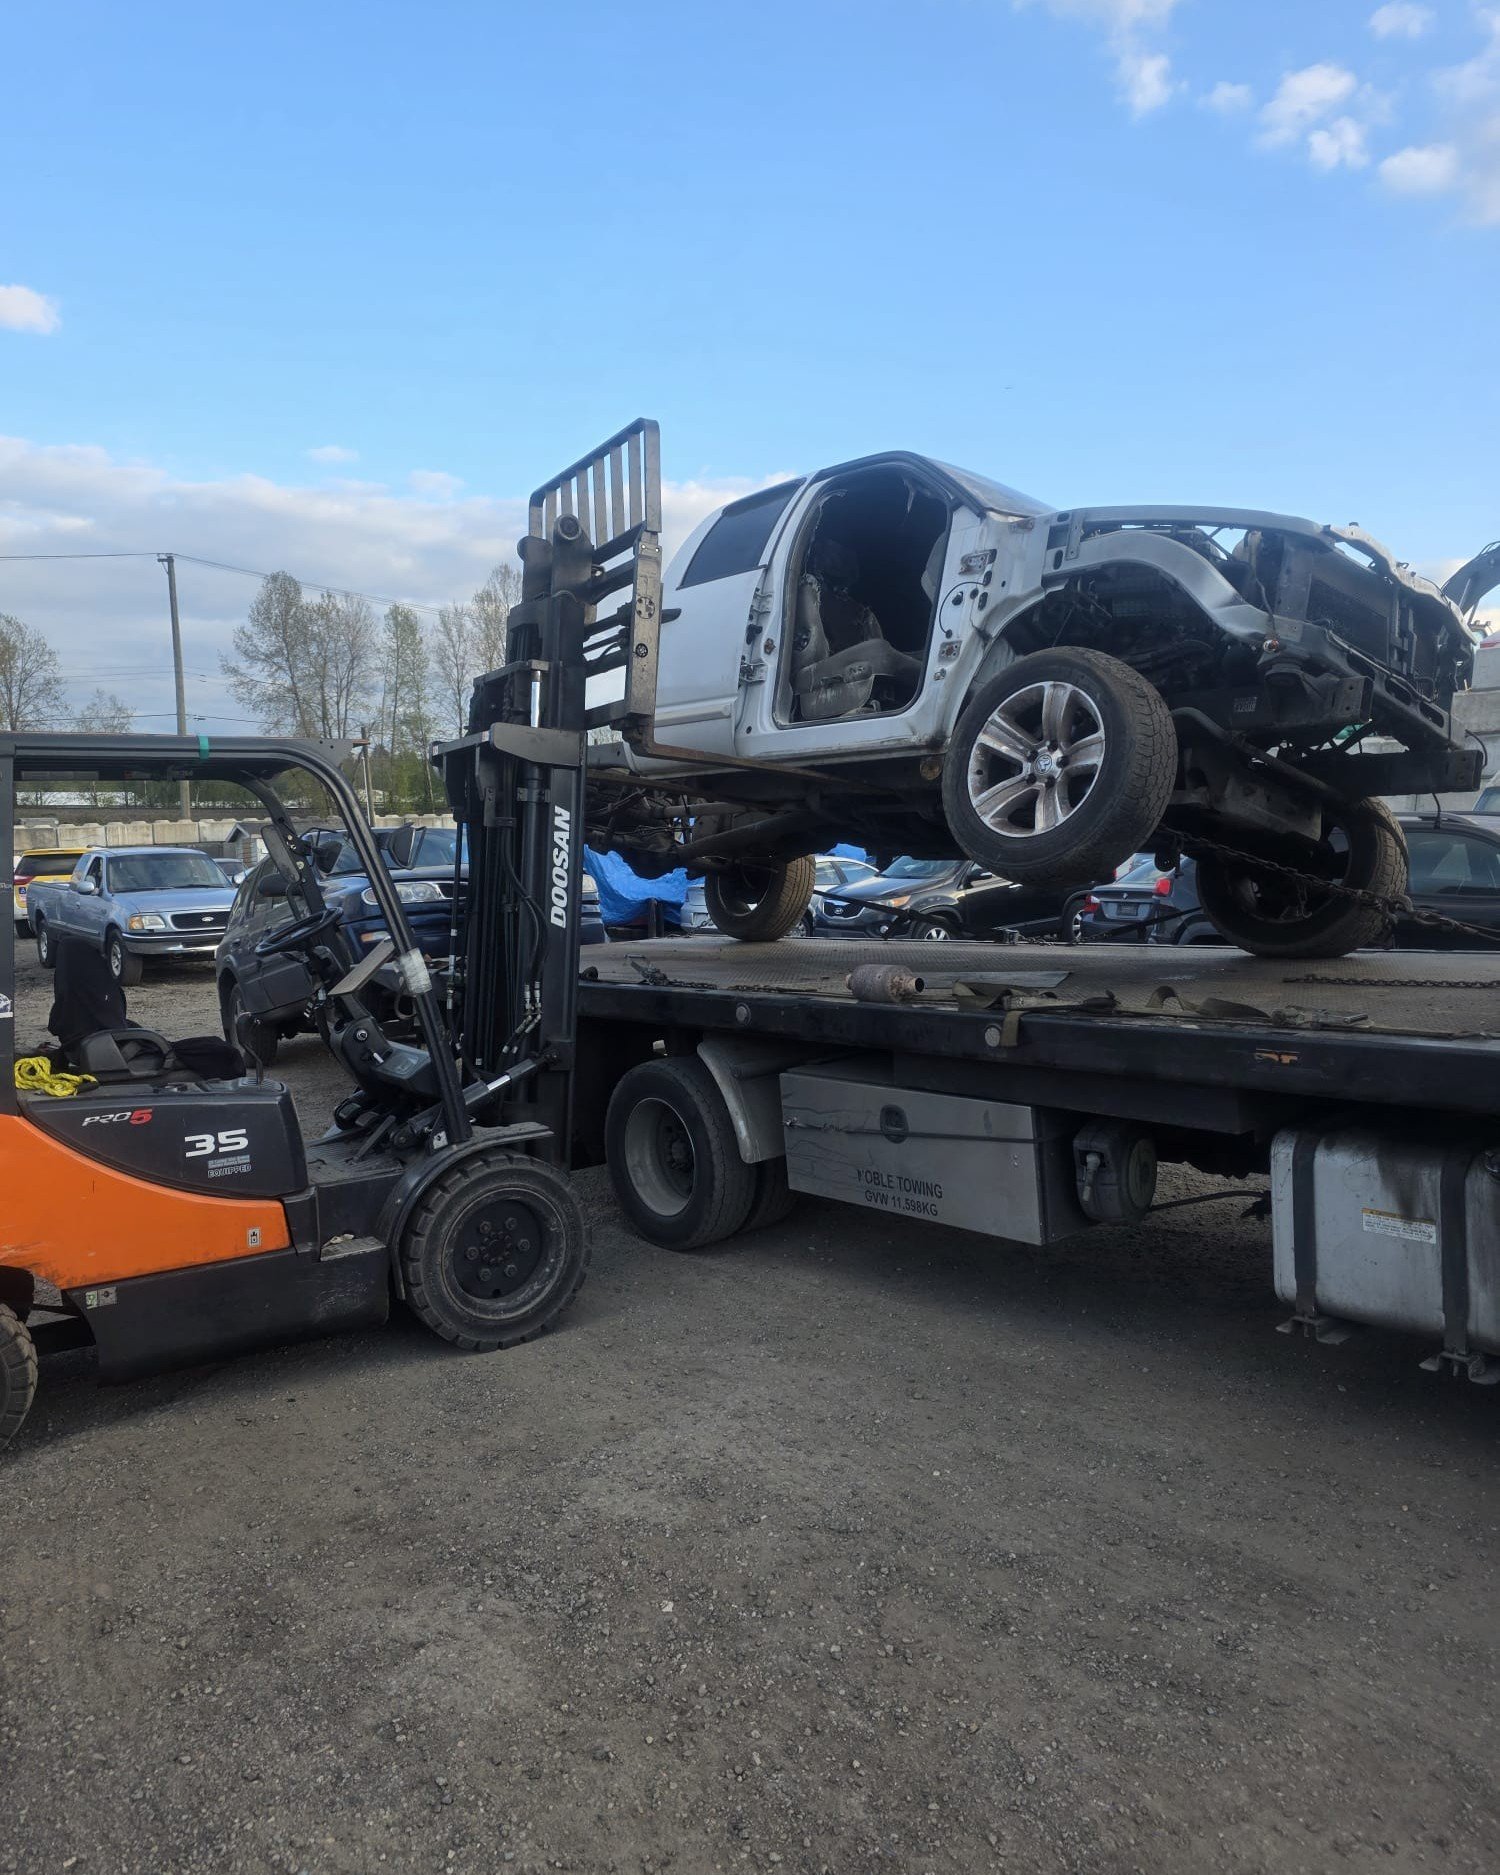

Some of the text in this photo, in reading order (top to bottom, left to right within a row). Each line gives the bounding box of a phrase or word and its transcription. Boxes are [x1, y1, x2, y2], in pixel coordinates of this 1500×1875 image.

[550, 805, 570, 929] DOOSAN
[82, 1108, 153, 1127] PRO5
[184, 1128, 249, 1158] 35
[207, 1164, 252, 1178] EQUIPPED
[864, 1190, 889, 1206] GVW
[896, 1176, 943, 1199] TOWING
